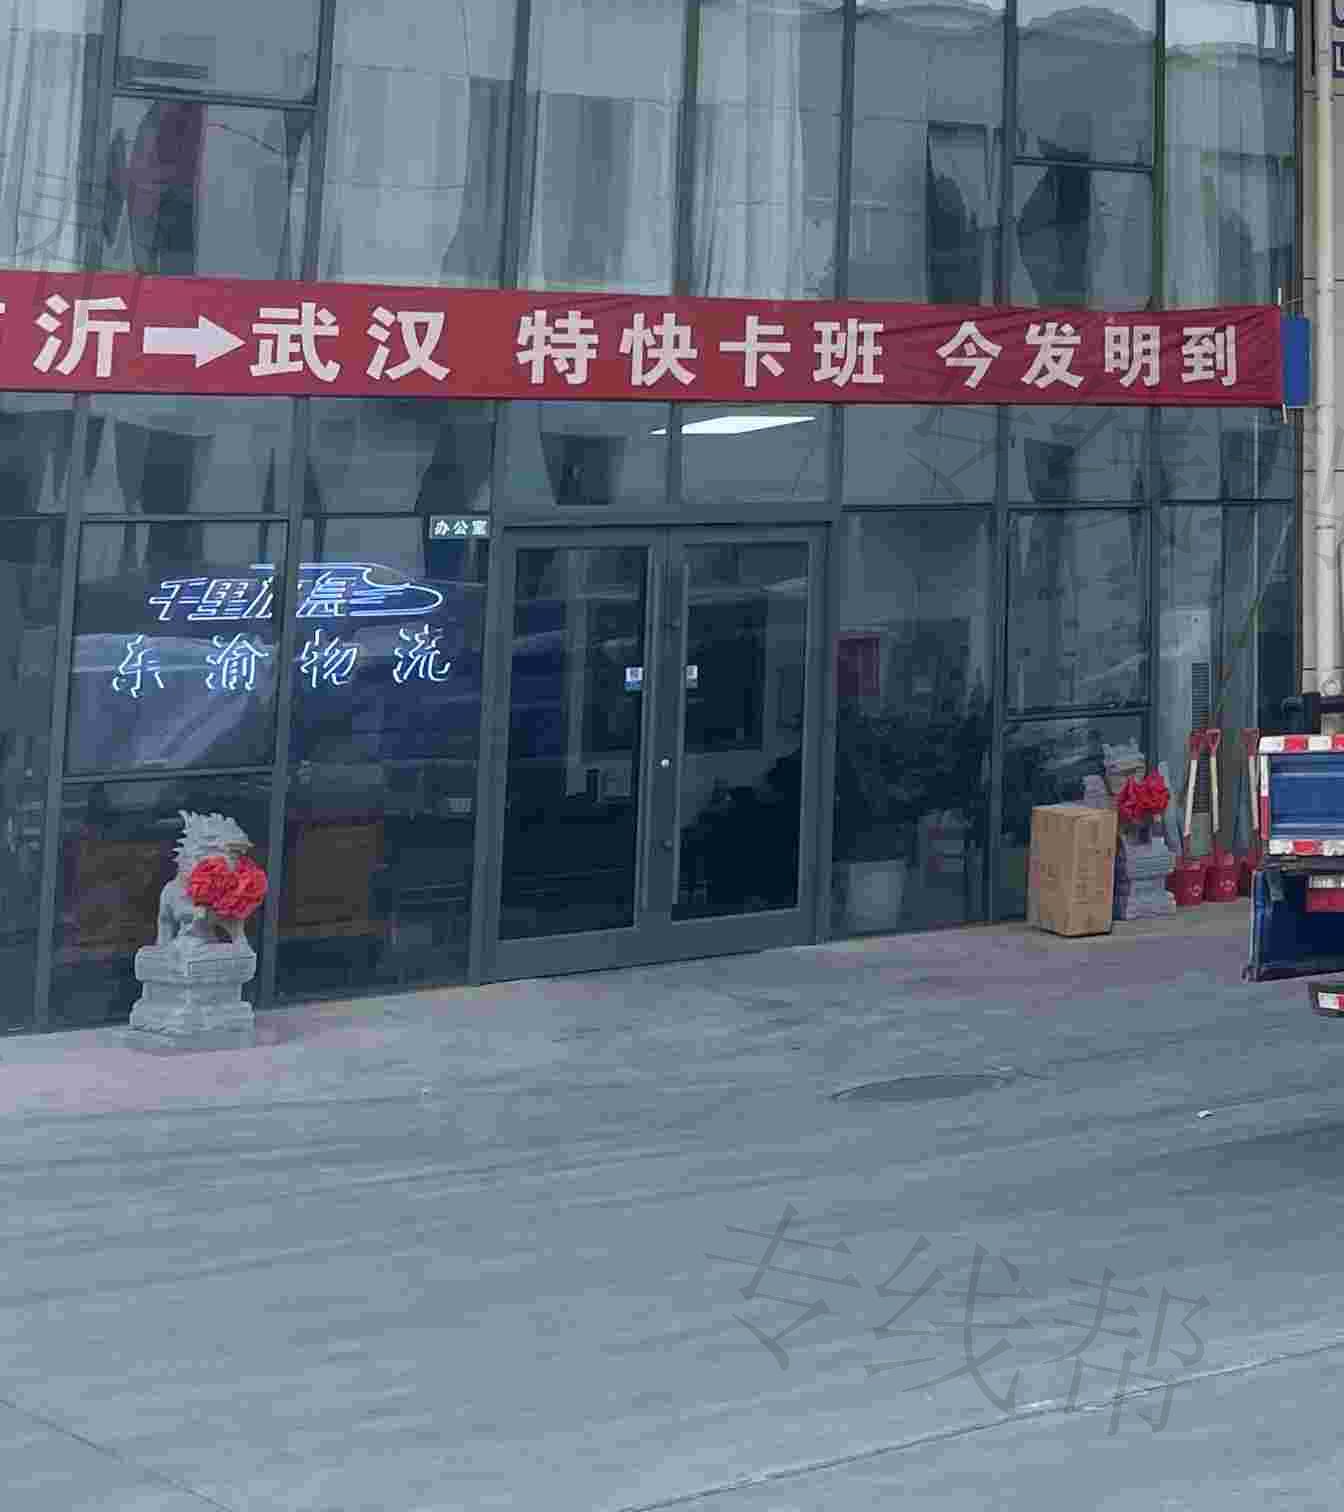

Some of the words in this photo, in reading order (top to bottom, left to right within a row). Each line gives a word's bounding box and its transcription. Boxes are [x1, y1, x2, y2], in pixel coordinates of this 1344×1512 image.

[0, 292, 131, 378] 沂
[249, 301, 452, 382] 武汉
[516, 309, 885, 388] 特快卡班
[936, 320, 1238, 388] 今发明到
[434, 519, 488, 537] 办公室
[111, 624, 450, 698] 东渝物流
